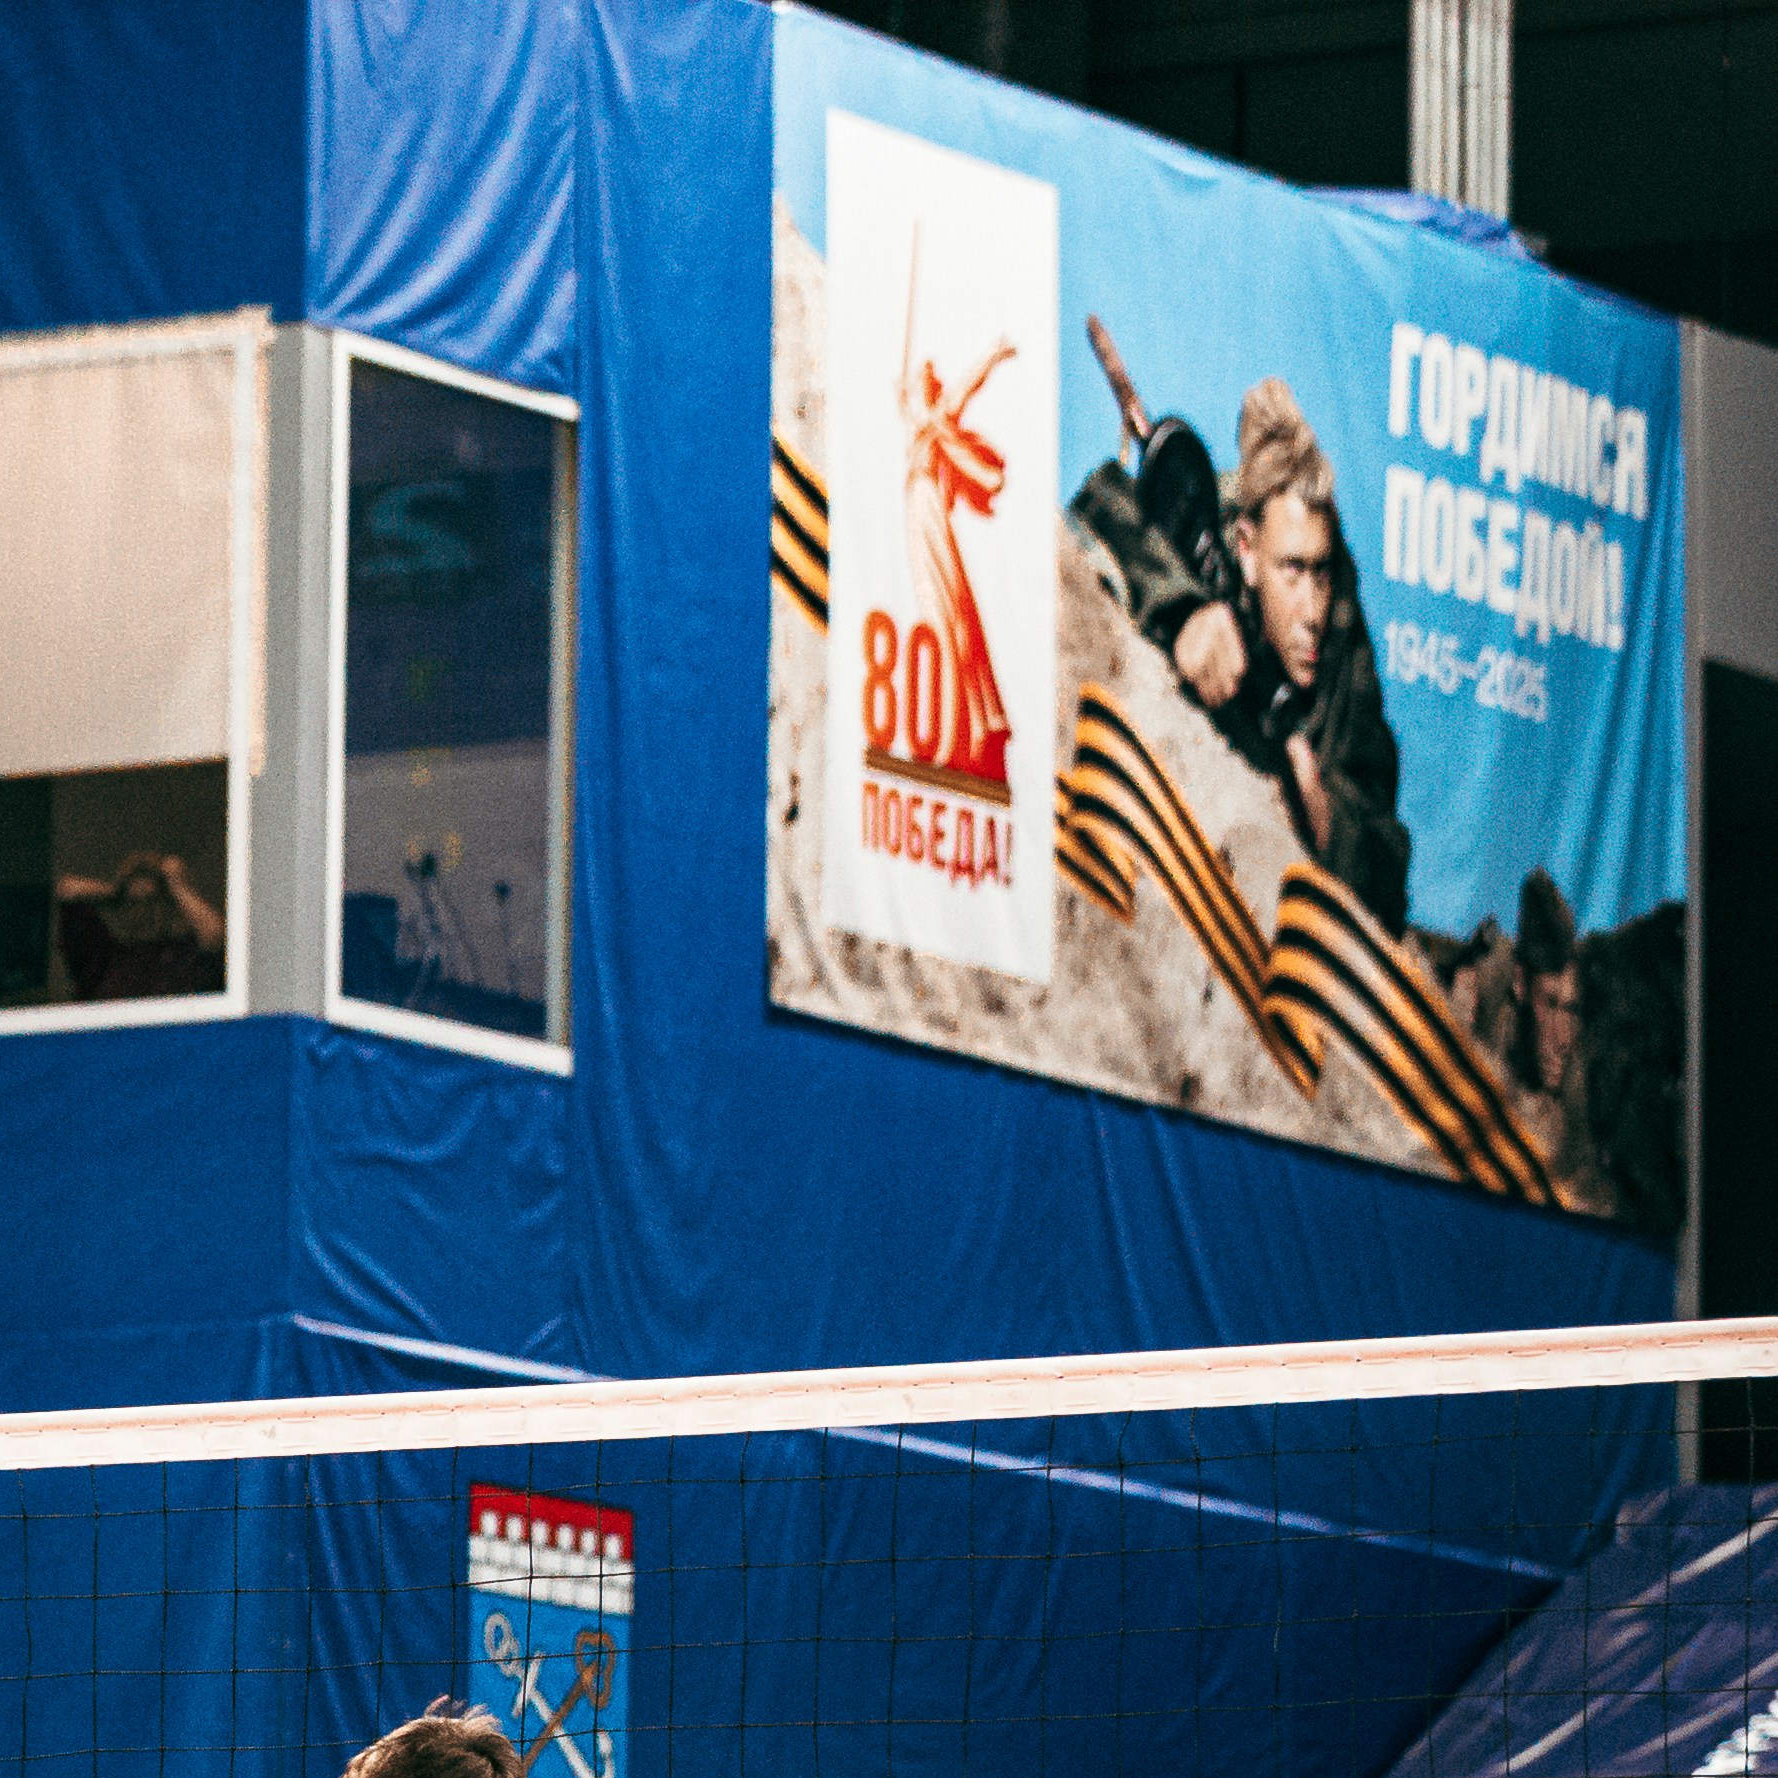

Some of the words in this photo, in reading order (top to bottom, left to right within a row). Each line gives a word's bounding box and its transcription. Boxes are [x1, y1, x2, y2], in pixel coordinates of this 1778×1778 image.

[1388, 321, 1648, 520] ГОРДИМСЯ
[1383, 464, 1626, 653] ПОБЕДОЙ!
[862, 609, 942, 765] 80
[862, 781, 1013, 890] ПОБЕДА!
